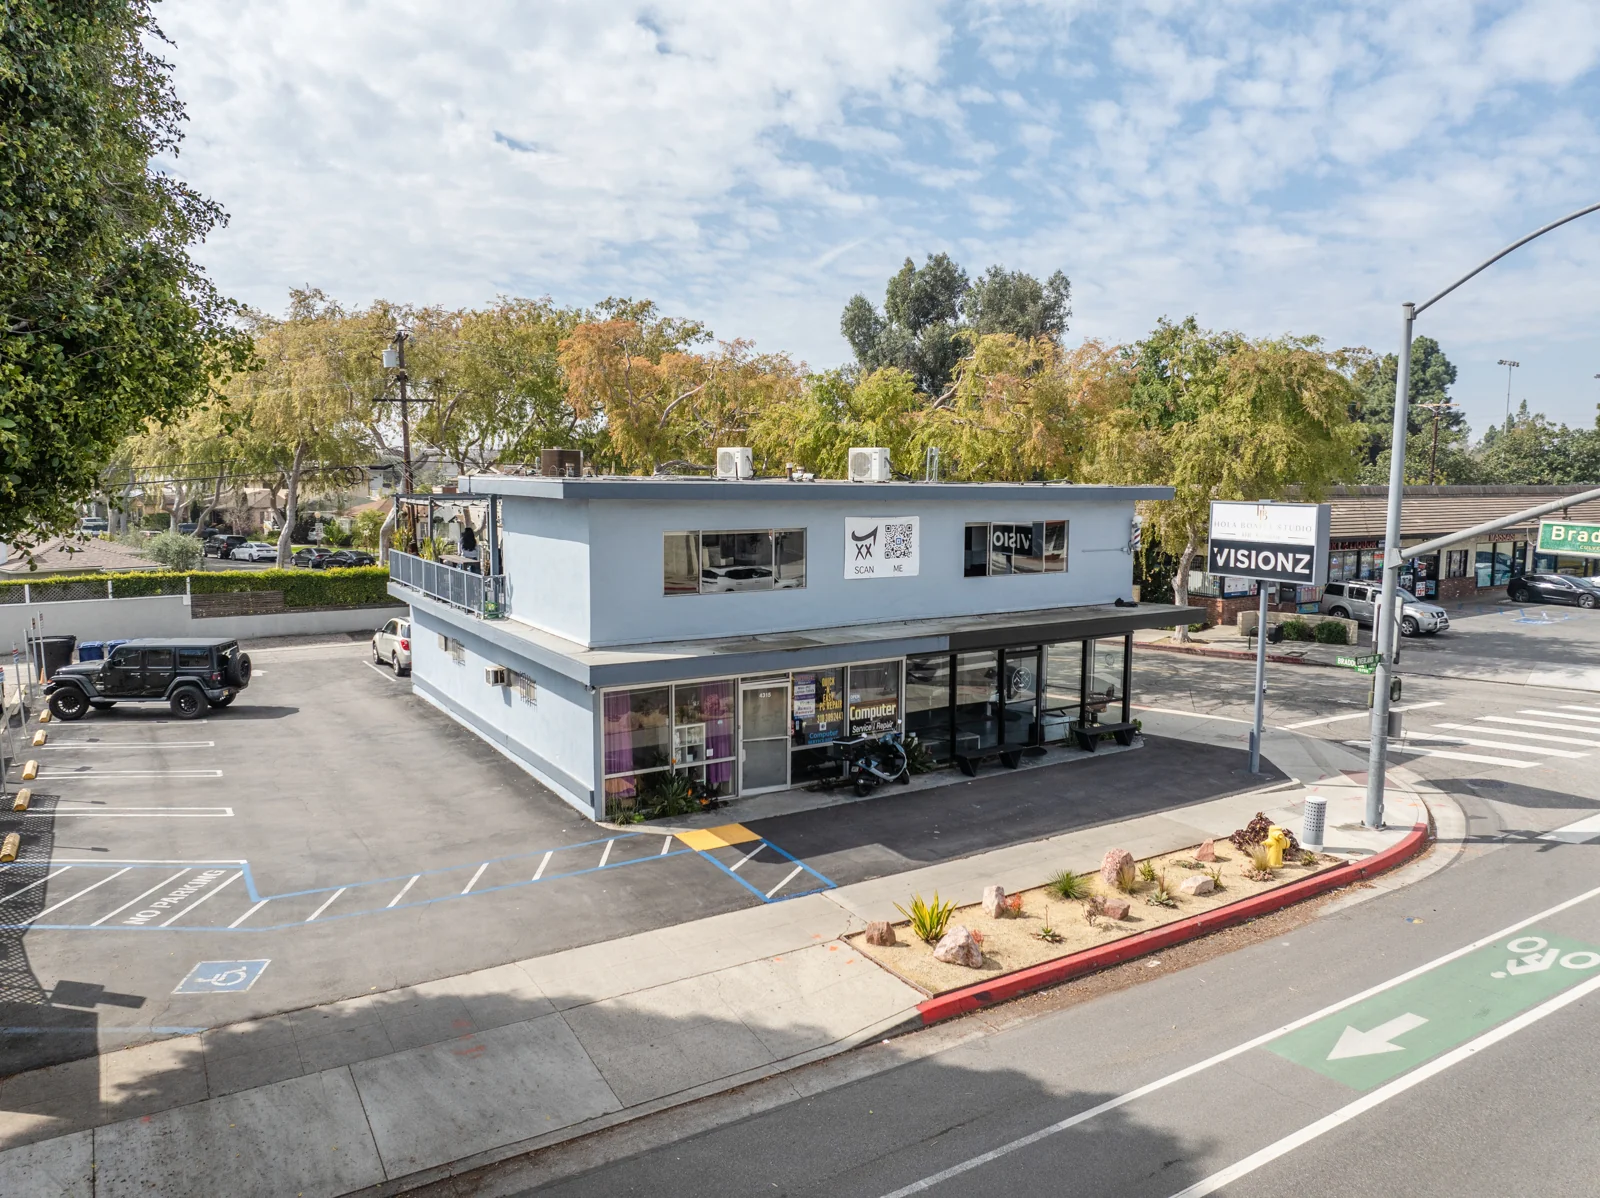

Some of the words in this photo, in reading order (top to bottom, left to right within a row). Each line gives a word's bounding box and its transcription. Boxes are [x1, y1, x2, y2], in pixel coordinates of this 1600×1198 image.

[1551, 525, 1600, 543] Brad
[854, 565, 875, 574] SCAN
[893, 564, 904, 572] ME
[1213, 548, 1310, 574] VISIONZ
[850, 703, 896, 721] Computer
[809, 730, 839, 739] Computer
[852, 723, 872, 733] Service
[876, 720, 894, 731] Repair
[123, 910, 160, 925] NO
[149, 869, 227, 908] PARKING
